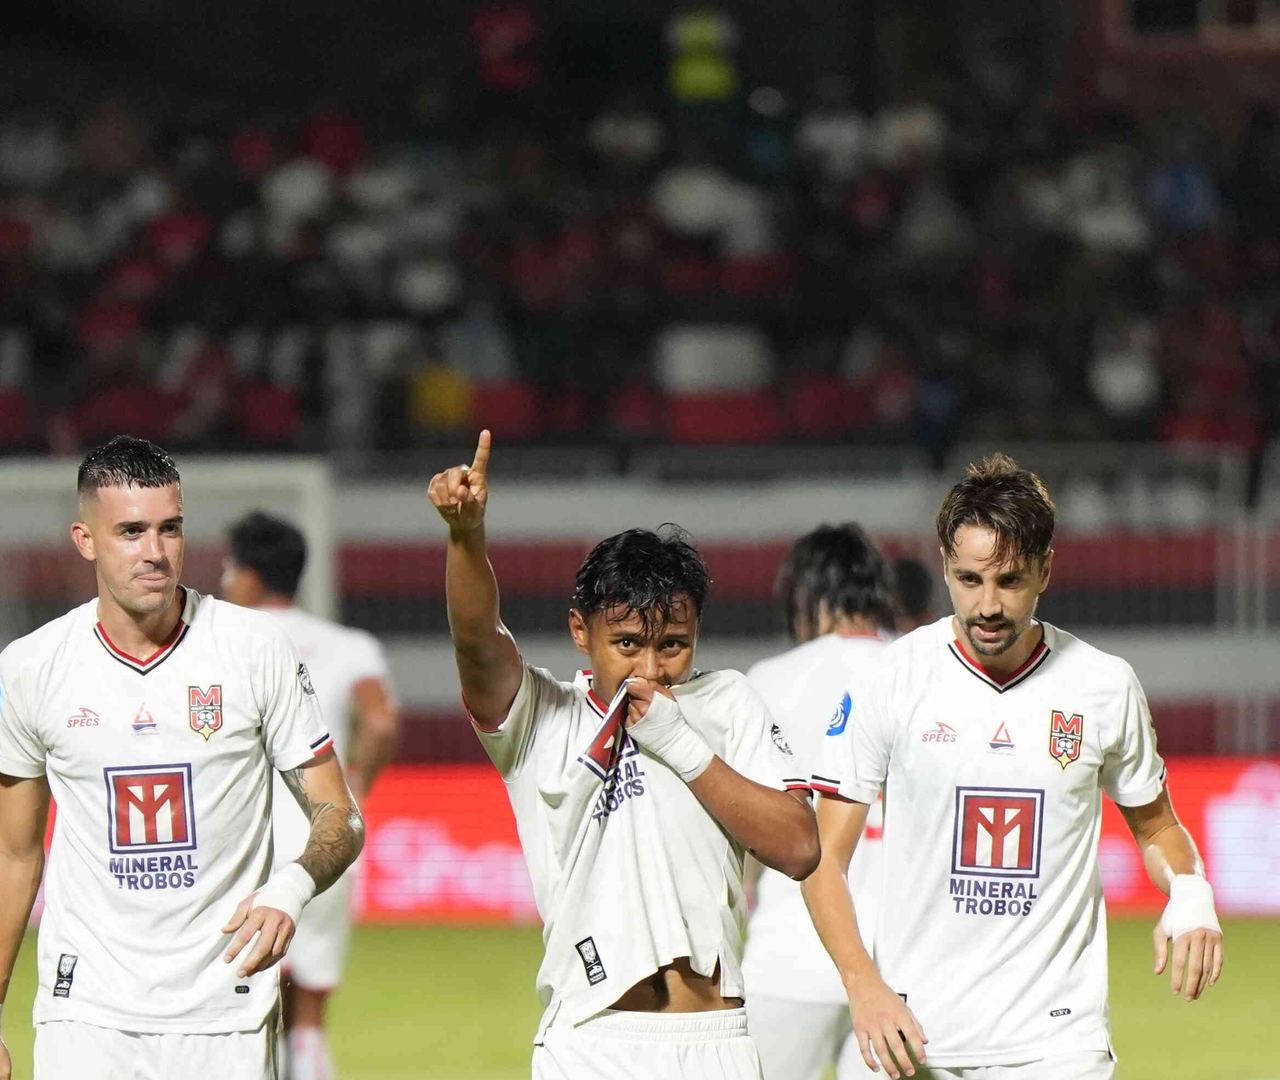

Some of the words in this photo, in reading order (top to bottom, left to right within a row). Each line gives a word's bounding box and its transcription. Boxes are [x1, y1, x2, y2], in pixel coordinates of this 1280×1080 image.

[66, 717, 100, 729] SPECS
[921, 733, 957, 743] SPECS
[109, 854, 198, 874] MINERAL
[114, 871, 195, 890] TROBOS
[949, 878, 1037, 899] MINERAL
[953, 896, 1032, 916] TROBOS
